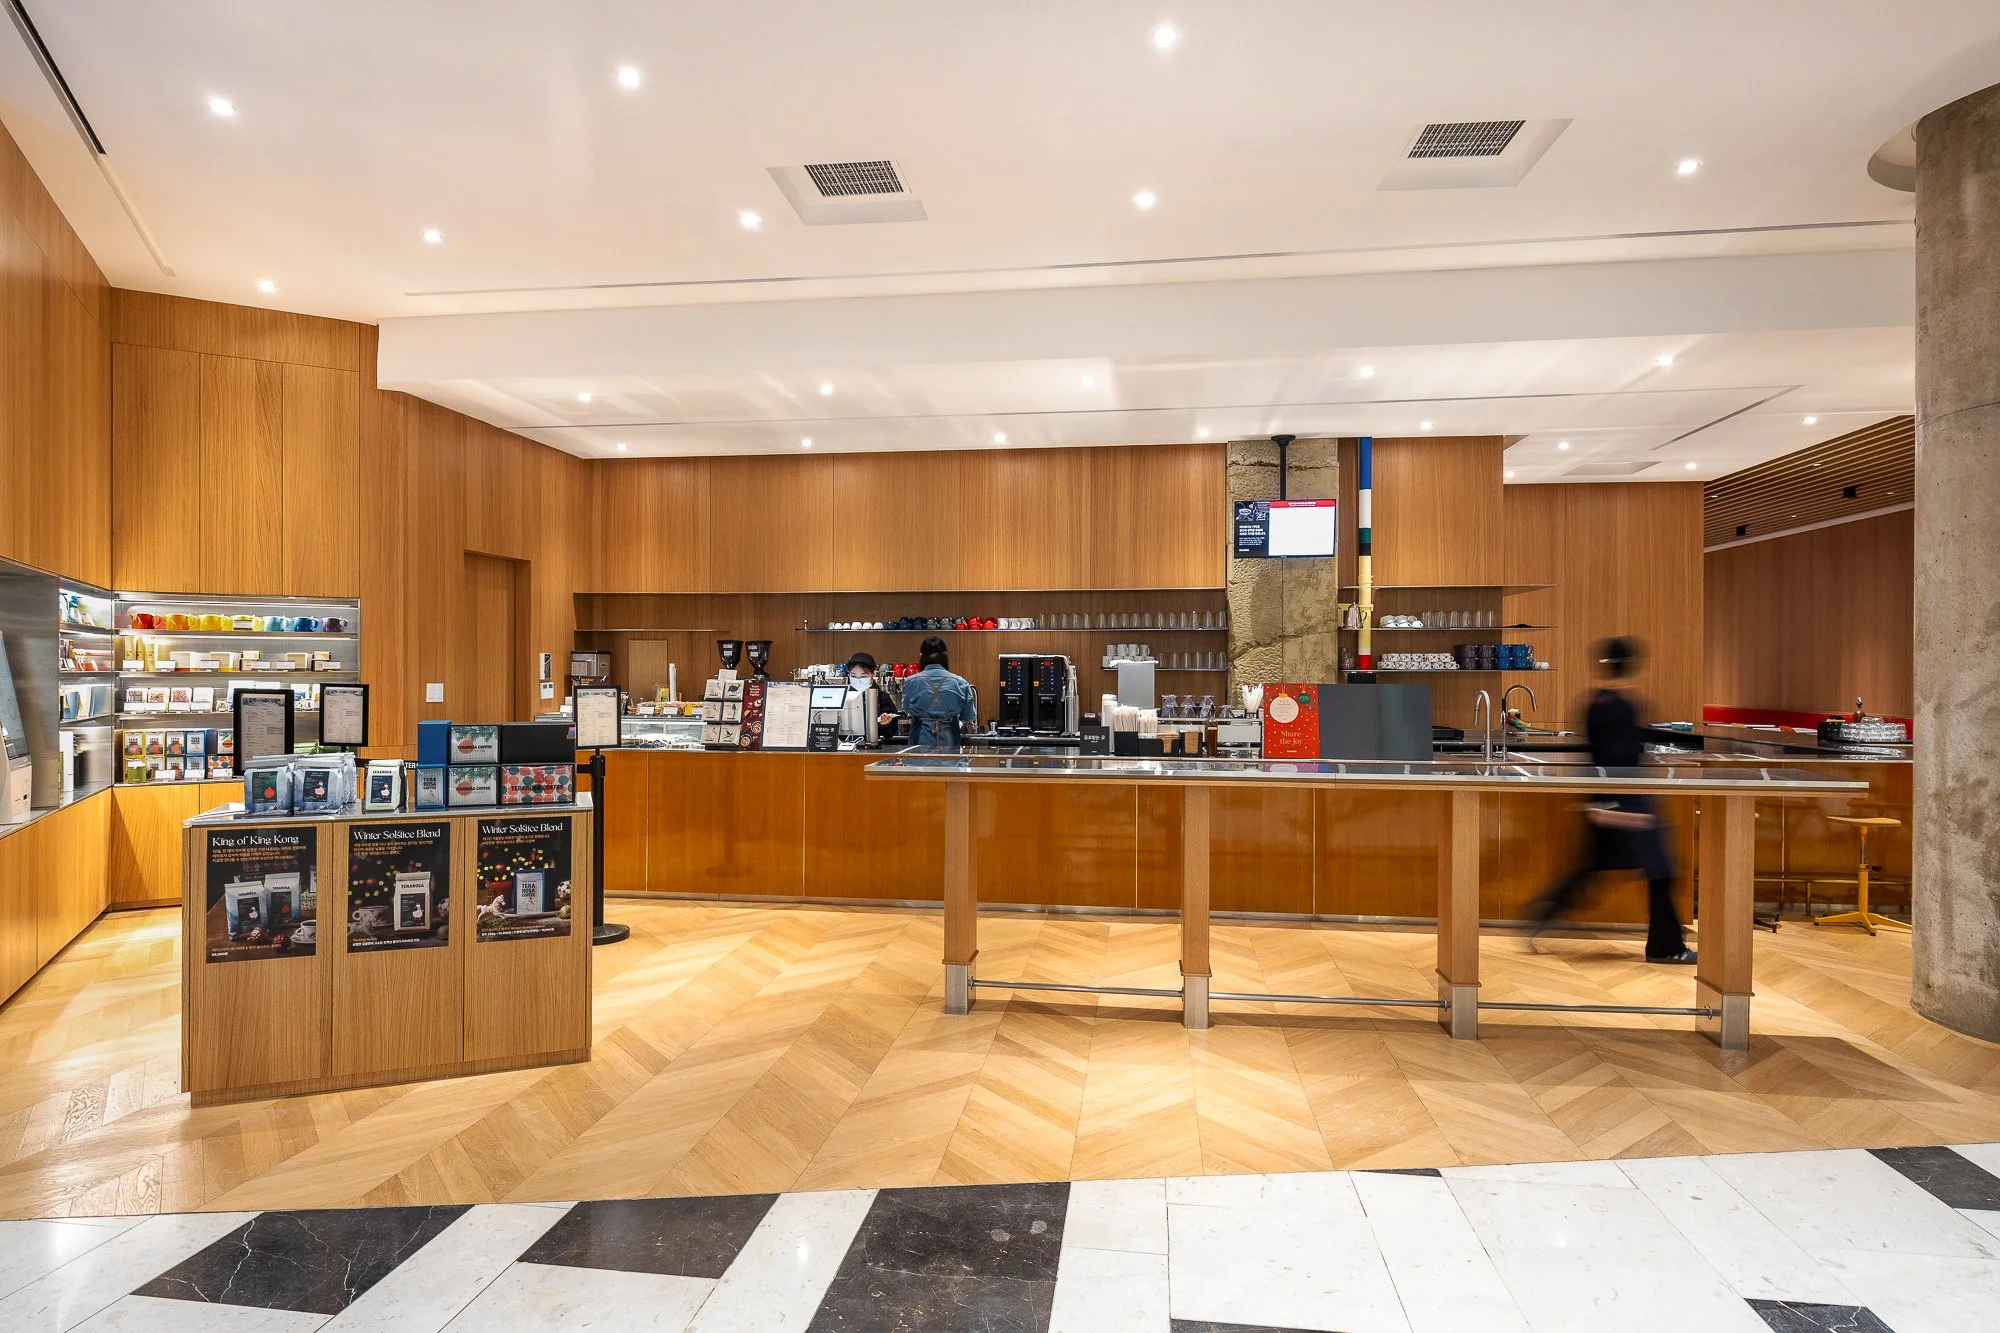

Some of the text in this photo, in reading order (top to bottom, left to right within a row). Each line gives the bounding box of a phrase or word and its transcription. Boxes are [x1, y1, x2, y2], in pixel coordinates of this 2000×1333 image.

[354, 828, 440, 839] Winter Solstice Blend
[482, 822, 563, 834] Winter Solstice Blend
[212, 835, 299, 846] King of King Kong
